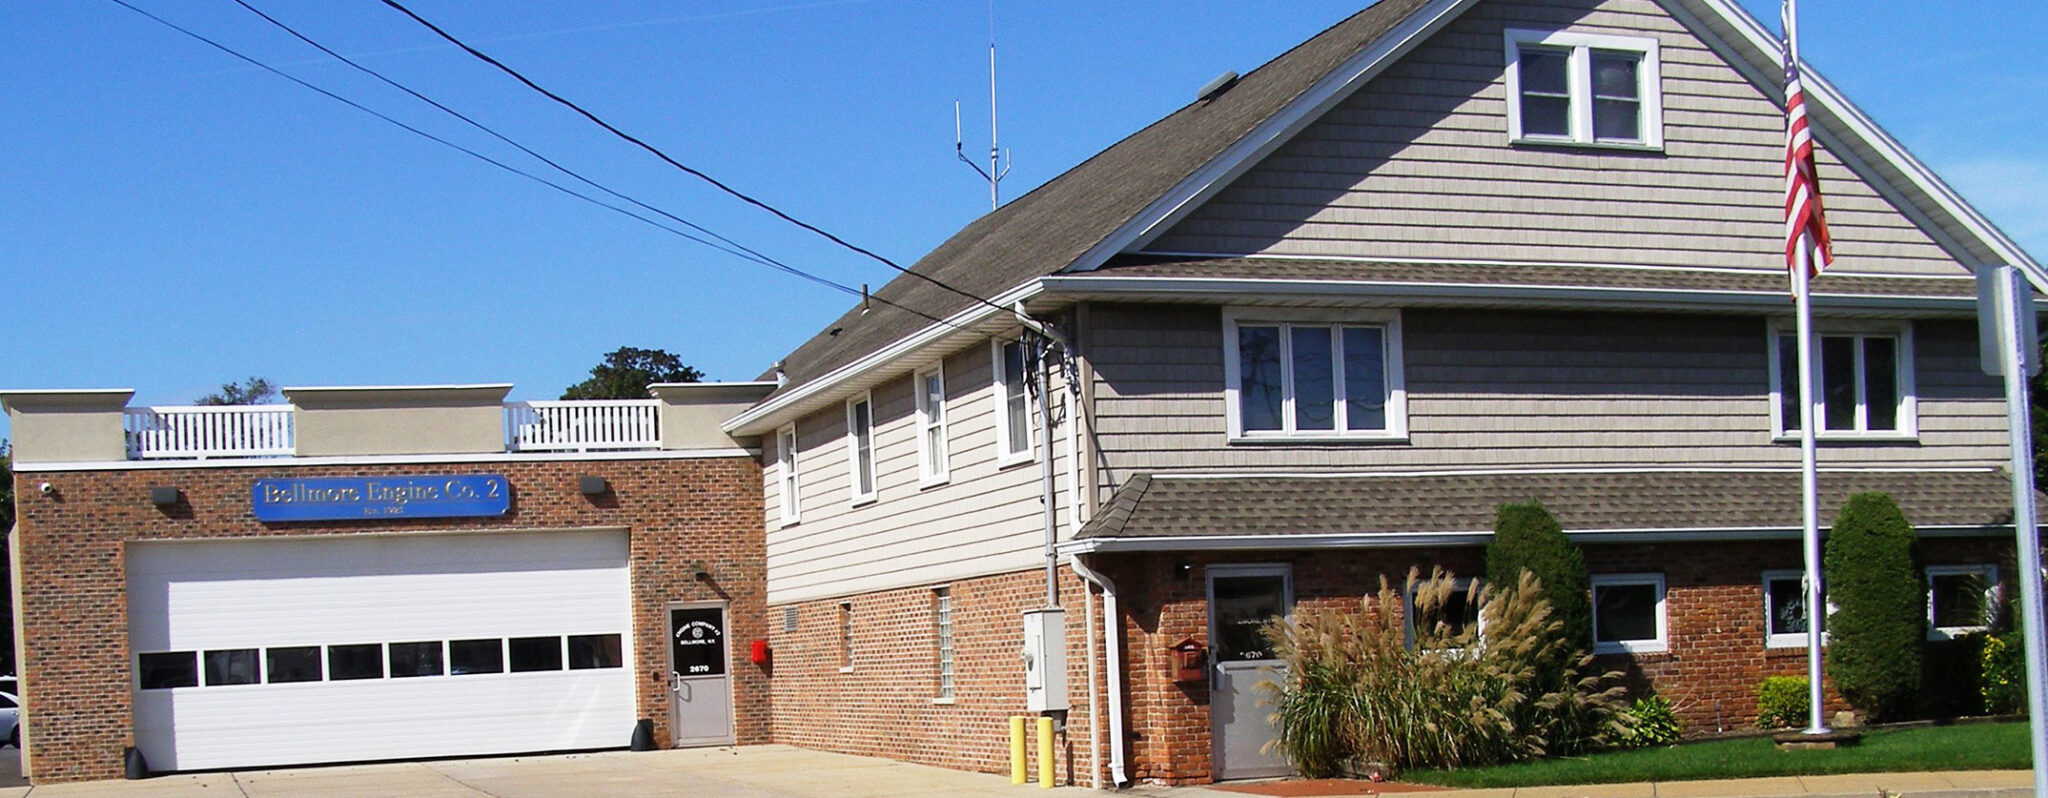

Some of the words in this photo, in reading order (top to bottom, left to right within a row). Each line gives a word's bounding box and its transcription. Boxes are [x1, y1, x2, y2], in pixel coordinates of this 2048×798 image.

[263, 483, 360, 503] Bellmore
[366, 480, 439, 504] Engine
[444, 479, 481, 499] Co.
[486, 479, 500, 498] 2
[689, 665, 709, 673] 2670
